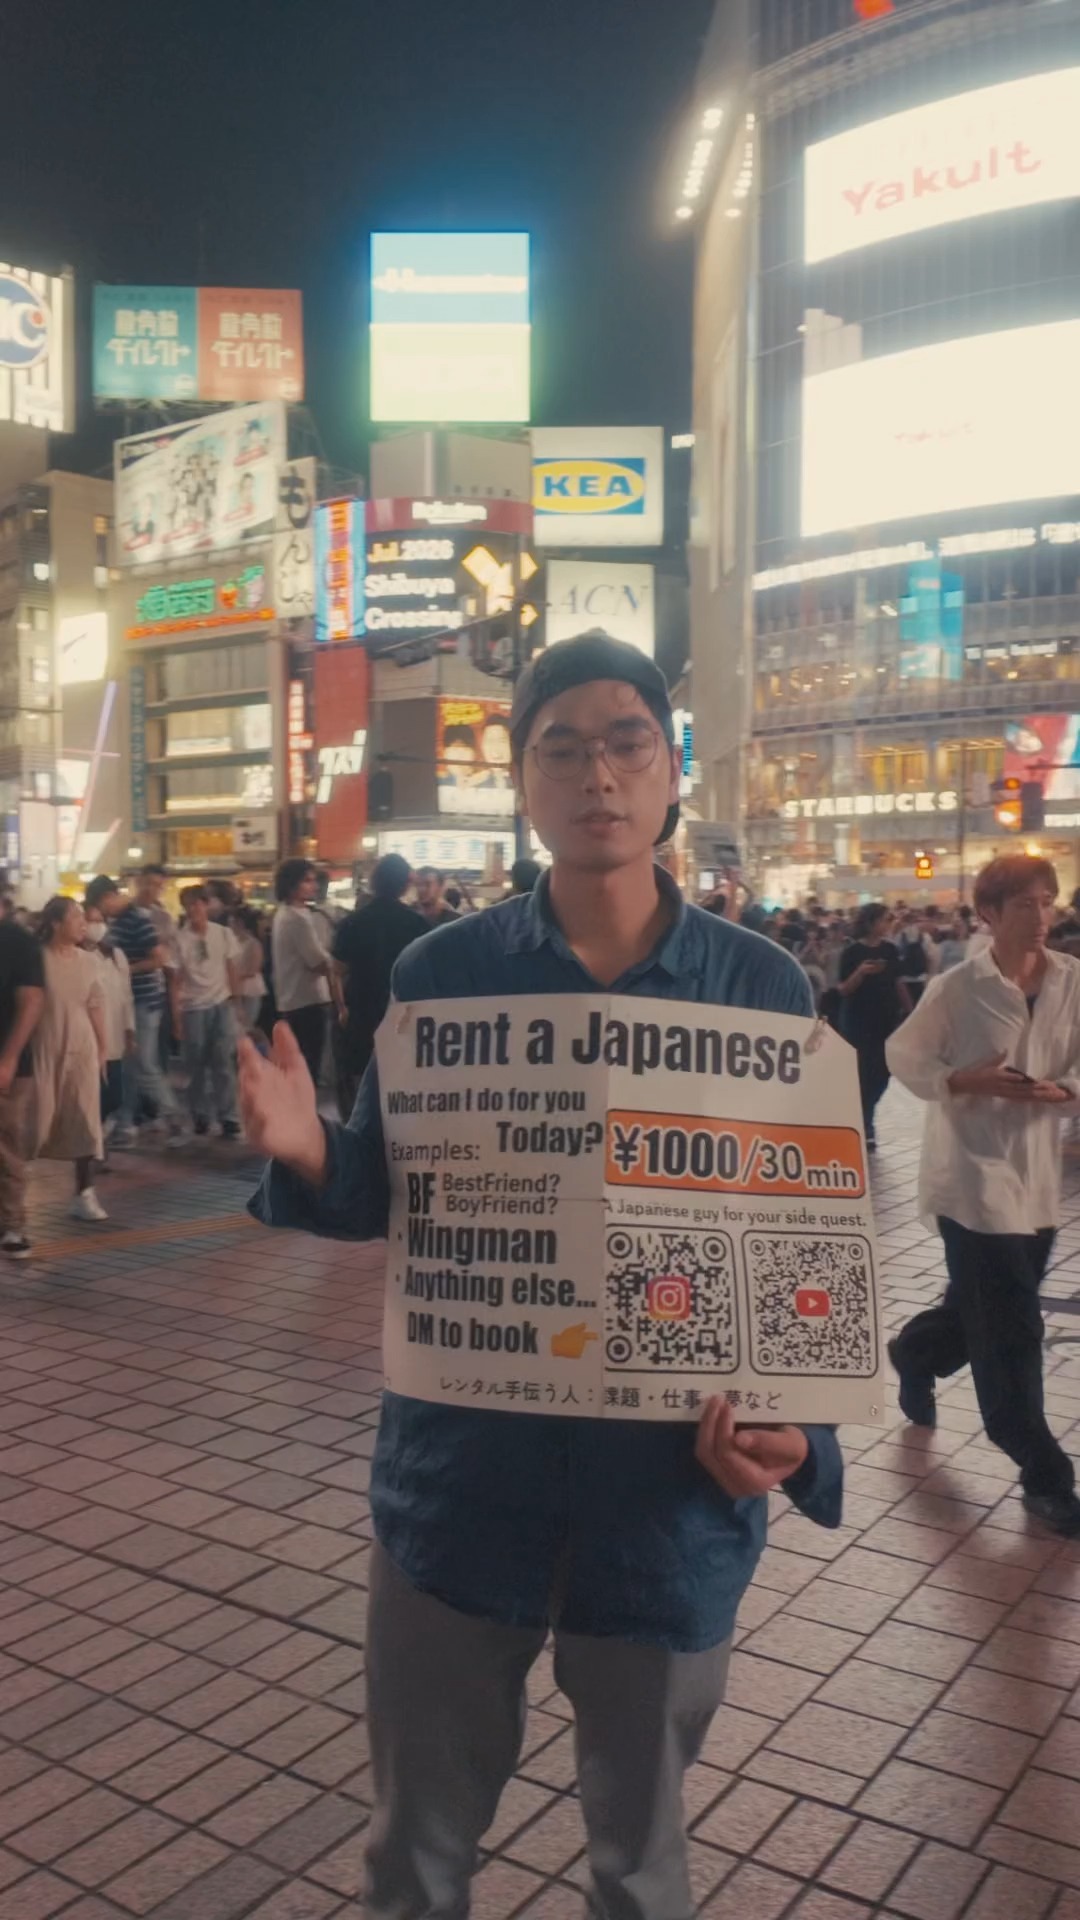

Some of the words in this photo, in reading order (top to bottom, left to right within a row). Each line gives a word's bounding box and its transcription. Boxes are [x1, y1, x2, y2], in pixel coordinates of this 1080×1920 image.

[842, 140, 1042, 215] Yakult
[543, 475, 634, 497] KEA
[365, 573, 455, 598] Shibuya
[364, 605, 463, 630] Crossing
[783, 791, 958, 818] STARBUCKS
[415, 1012, 510, 1068] Rent
[526, 1018, 554, 1065] a
[571, 1011, 801, 1084] Japanese
[388, 1090, 422, 1114] What
[427, 1092, 460, 1113] can
[465, 1088, 472, 1112] I
[478, 1088, 504, 1112] do
[509, 1088, 540, 1112] for
[545, 1090, 585, 1114] you
[391, 1139, 480, 1166] Examples:
[496, 1121, 604, 1156] Today?
[407, 1172, 436, 1215] BF
[443, 1173, 561, 1194] BestFriend?
[446, 1195, 559, 1218] BoyFriend?
[617, 1198, 689, 1217] Japanese
[693, 1208, 720, 1223] guy
[723, 1205, 744, 1222] for
[747, 1209, 781, 1226] your
[785, 1207, 817, 1225] side
[820, 1211, 867, 1228] quest.
[407, 1216, 558, 1266] Wingman
[404, 1265, 504, 1307] Anything
[406, 1311, 434, 1346] DM
[440, 1317, 463, 1348] to
[468, 1317, 539, 1355] book
